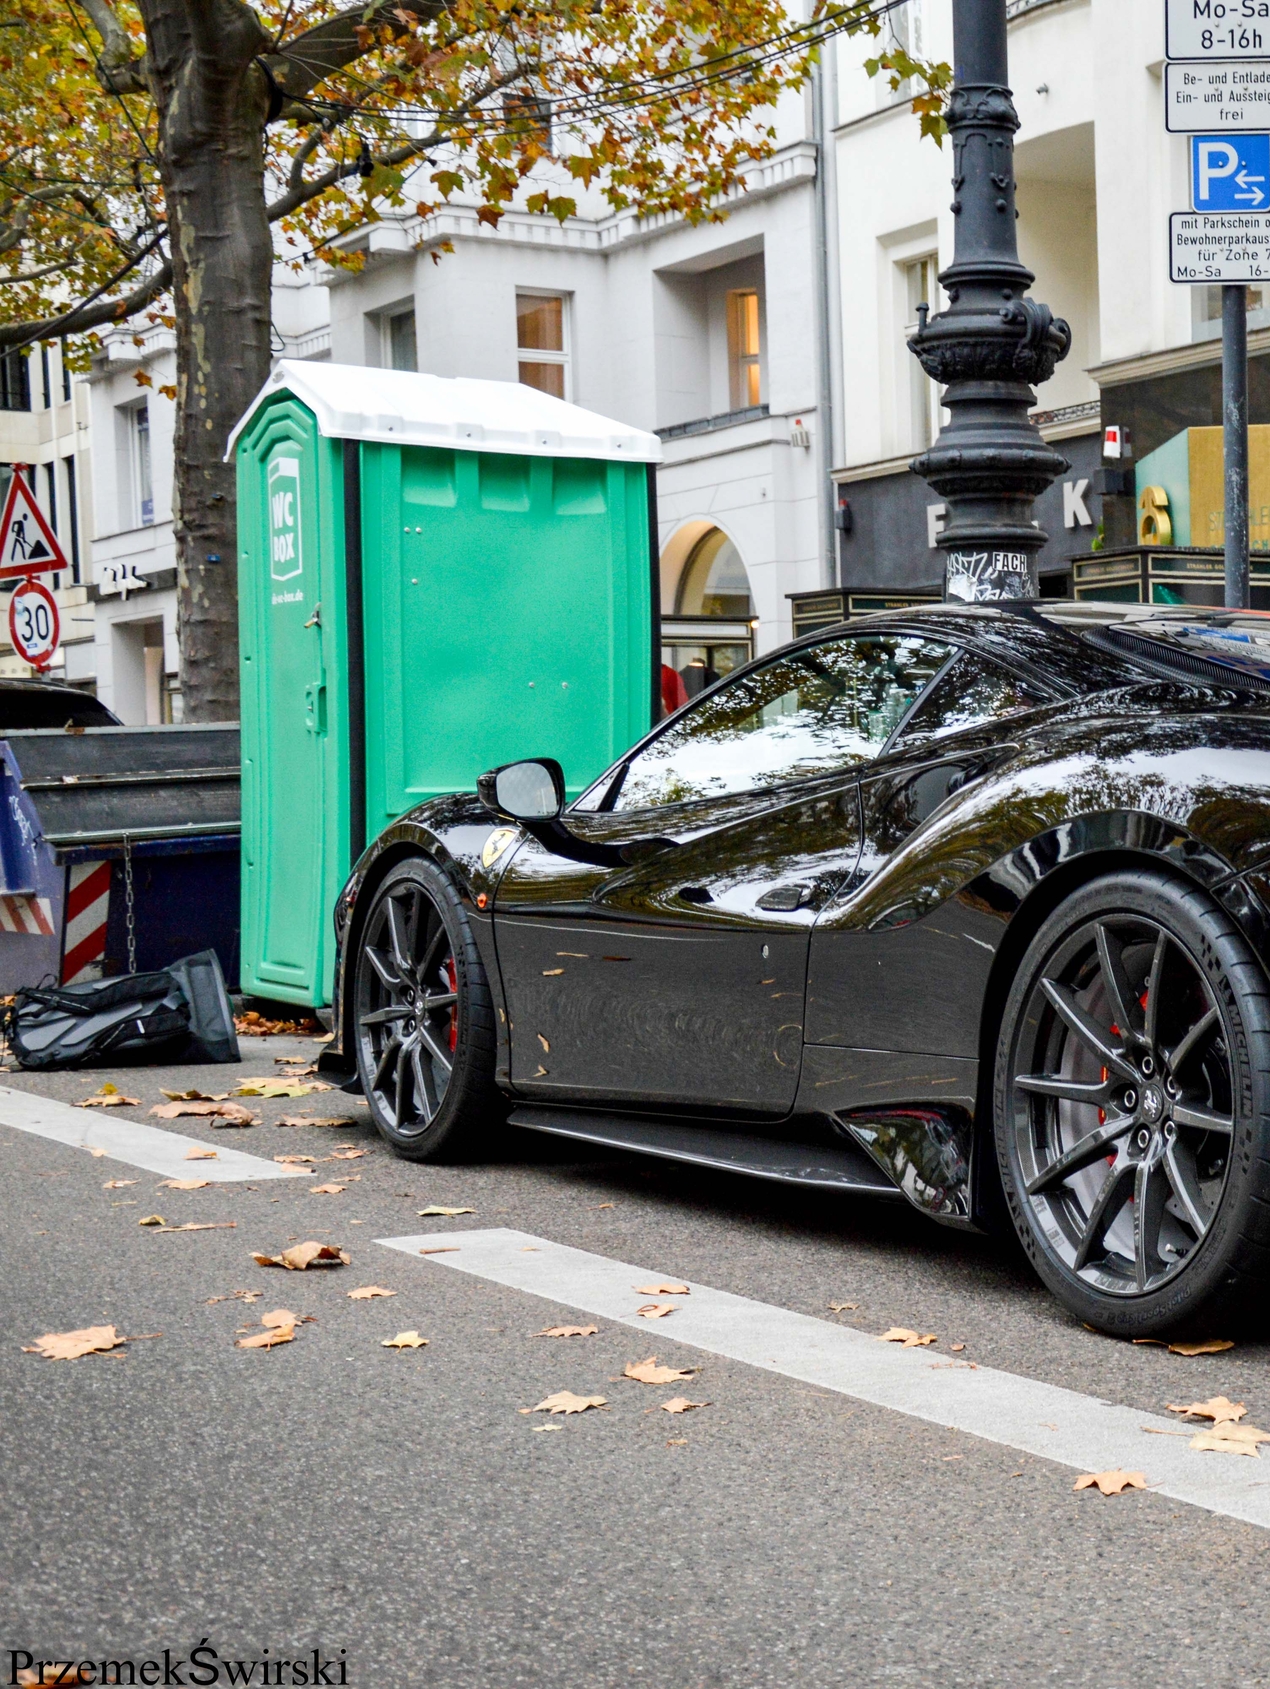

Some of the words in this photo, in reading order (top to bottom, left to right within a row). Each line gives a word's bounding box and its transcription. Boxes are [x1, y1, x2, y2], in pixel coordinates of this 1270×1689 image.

[1193, 0, 1269, 18] Mo-Sa
[1201, 29, 1262, 49] 8-16h
[1183, 73, 1203, 85] Be-
[1208, 72, 1227, 84] und
[1176, 91, 1198, 103] Ein-
[1204, 91, 1223, 103] und
[1219, 108, 1244, 120] frei
[1198, 142, 1239, 200] P
[1181, 217, 1198, 229] mit
[1203, 216, 1260, 229] Parkschein
[1198, 250, 1217, 261] für
[1225, 248, 1259, 261] Zone
[1177, 265, 1222, 278] Mo-Sa
[272, 492, 294, 529] WC
[273, 532, 295, 562] BOX
[994, 553, 1027, 571] FACH
[21, 604, 49, 643] 30
[1228, 1007, 1253, 1117] MICHELIN
